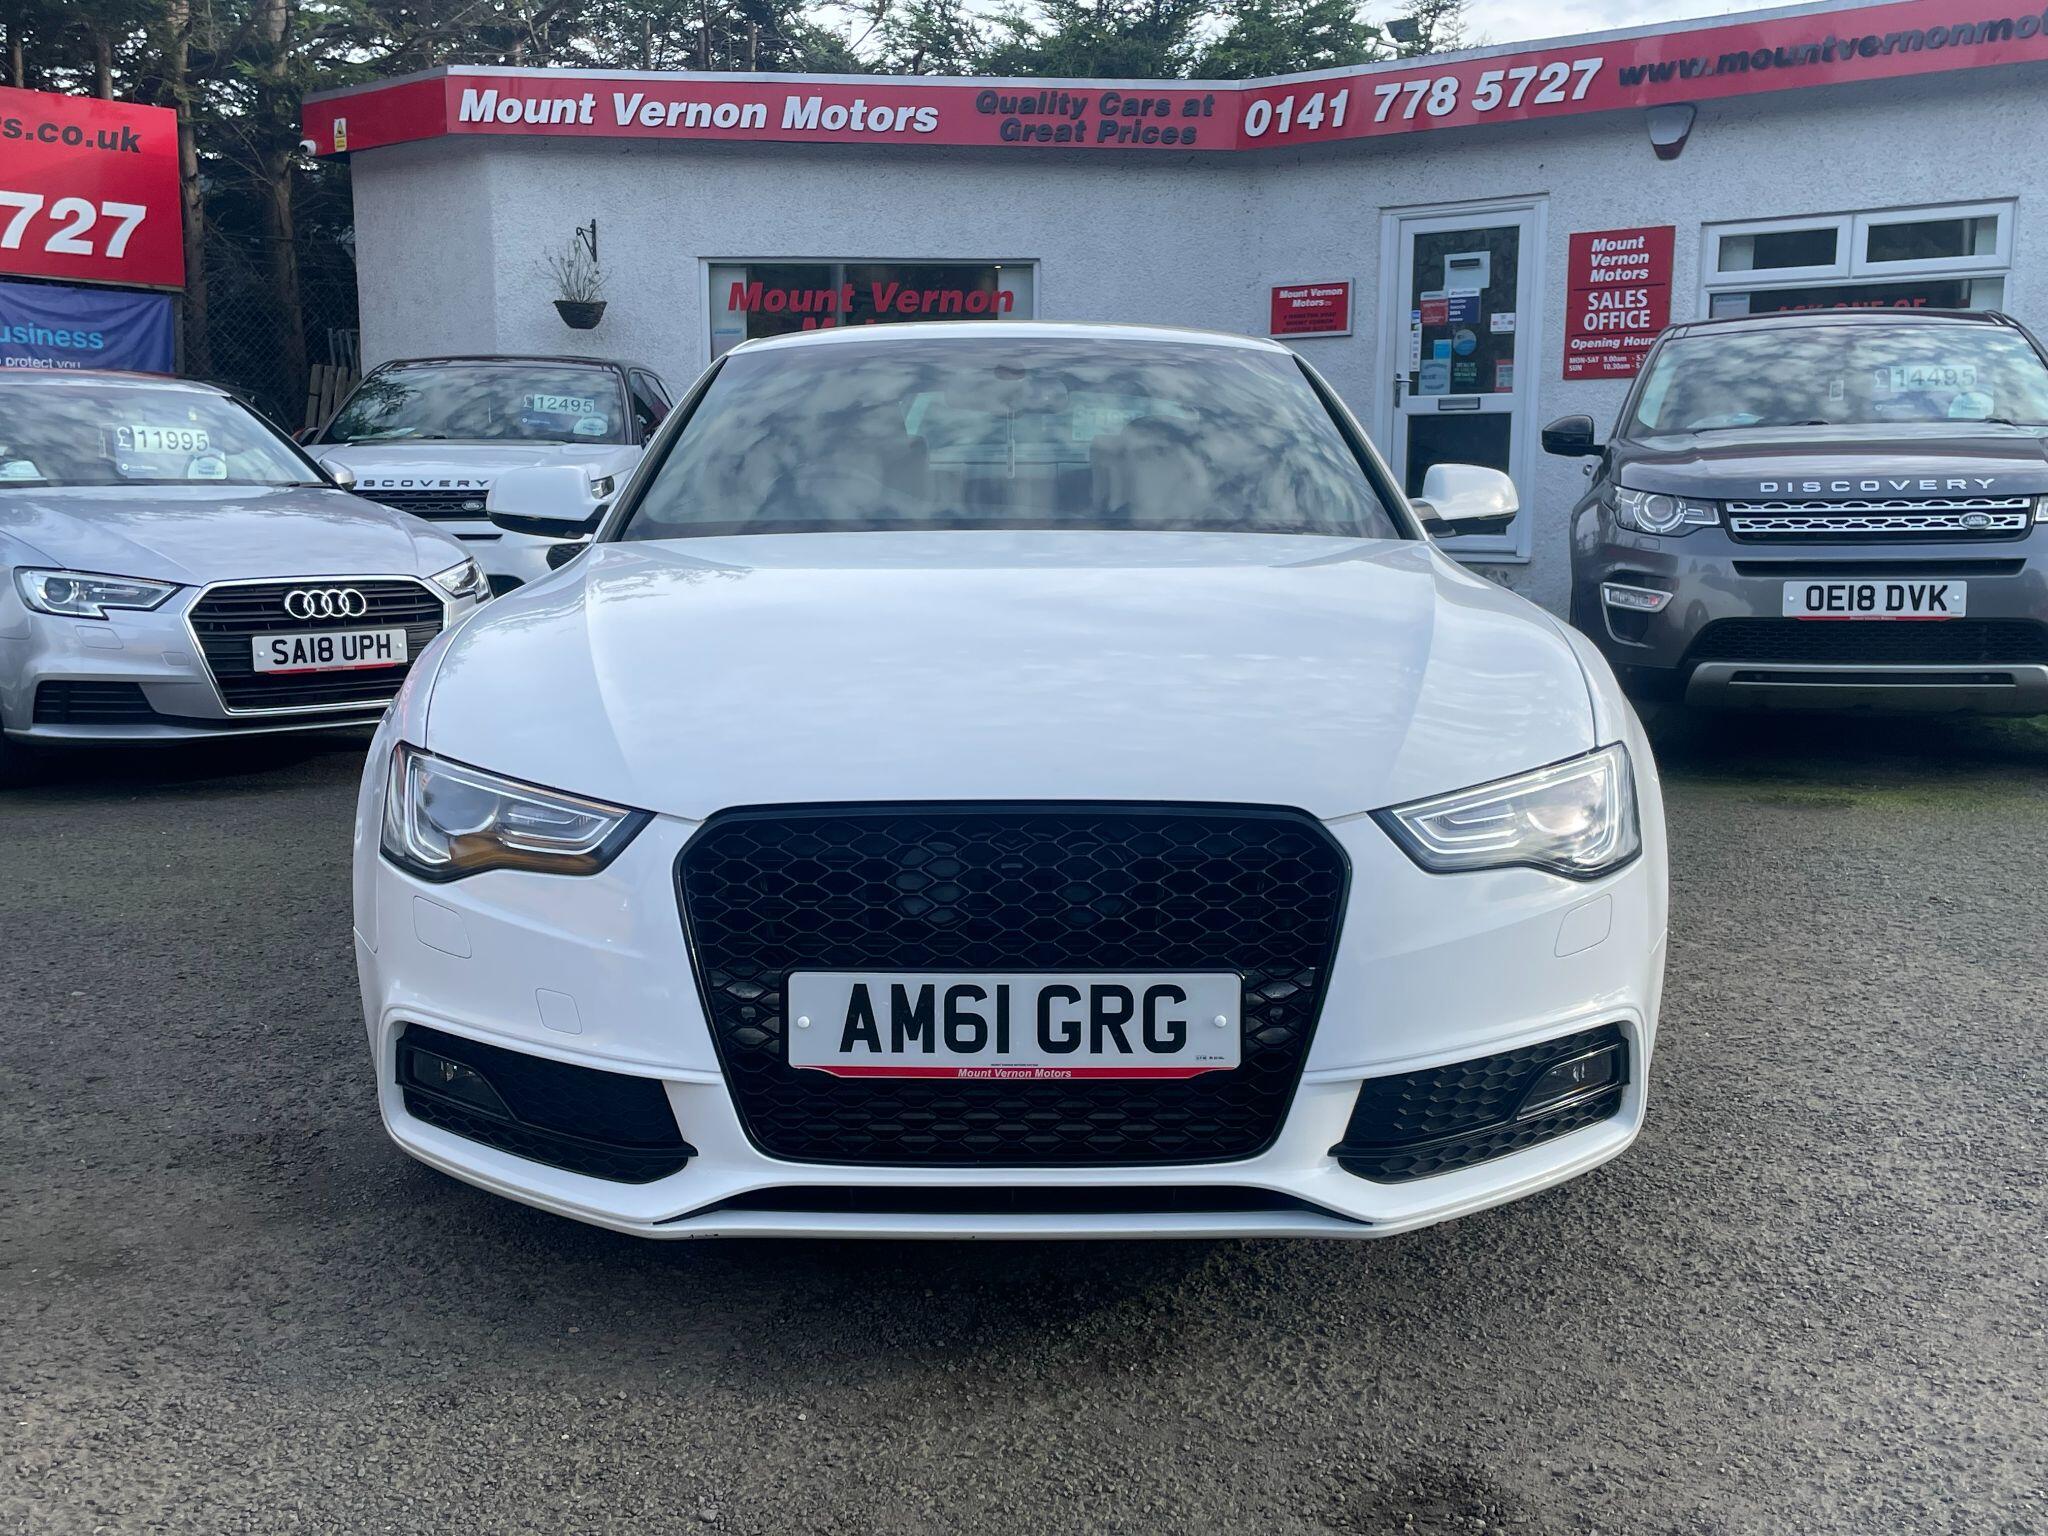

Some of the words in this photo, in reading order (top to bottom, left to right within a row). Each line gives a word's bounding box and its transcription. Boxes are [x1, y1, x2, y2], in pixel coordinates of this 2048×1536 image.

[975, 89, 1088, 120] Quality
[1099, 91, 1171, 117] Cars
[1182, 93, 1215, 117] at
[1244, 88, 1350, 138] 0141
[1373, 76, 1461, 122] 778
[1470, 57, 1604, 112] 5727
[458, 88, 596, 125] Mount
[613, 92, 768, 129] Vernon
[781, 95, 939, 133] Motors
[0, 117, 142, 154] s.co.uk
[1000, 117, 1087, 143] Great
[1096, 119, 1197, 145] Prices
[0, 189, 148, 259] 727
[1591, 235, 1646, 252] Mount
[1590, 252, 1650, 268] Vernon
[1590, 268, 1649, 283] Motors
[727, 281, 857, 313] Mount
[871, 281, 1016, 314] Vernon
[1279, 289, 1308, 299] Mount
[1310, 287, 1343, 297] Vernon
[1292, 299, 1325, 308] Motors
[1587, 288, 1648, 311] SALES
[1583, 309, 1651, 331] OFFICE
[1570, 336, 1621, 350] Opening
[1623, 335, 1656, 347] Hour
[5, 355, 53, 369] protect
[1760, 477, 1995, 493] DISCOVERY
[1806, 585, 1875, 611] OE18
[1886, 585, 1948, 611] DVK
[271, 636, 334, 665] SA18
[342, 633, 392, 661] UPH
[839, 983, 1010, 1054] AM61
[1037, 983, 1188, 1054] GRG
[957, 1068, 991, 1078] Mount
[994, 1068, 1032, 1078] Vernon
[1034, 1068, 1072, 1078] Motors
